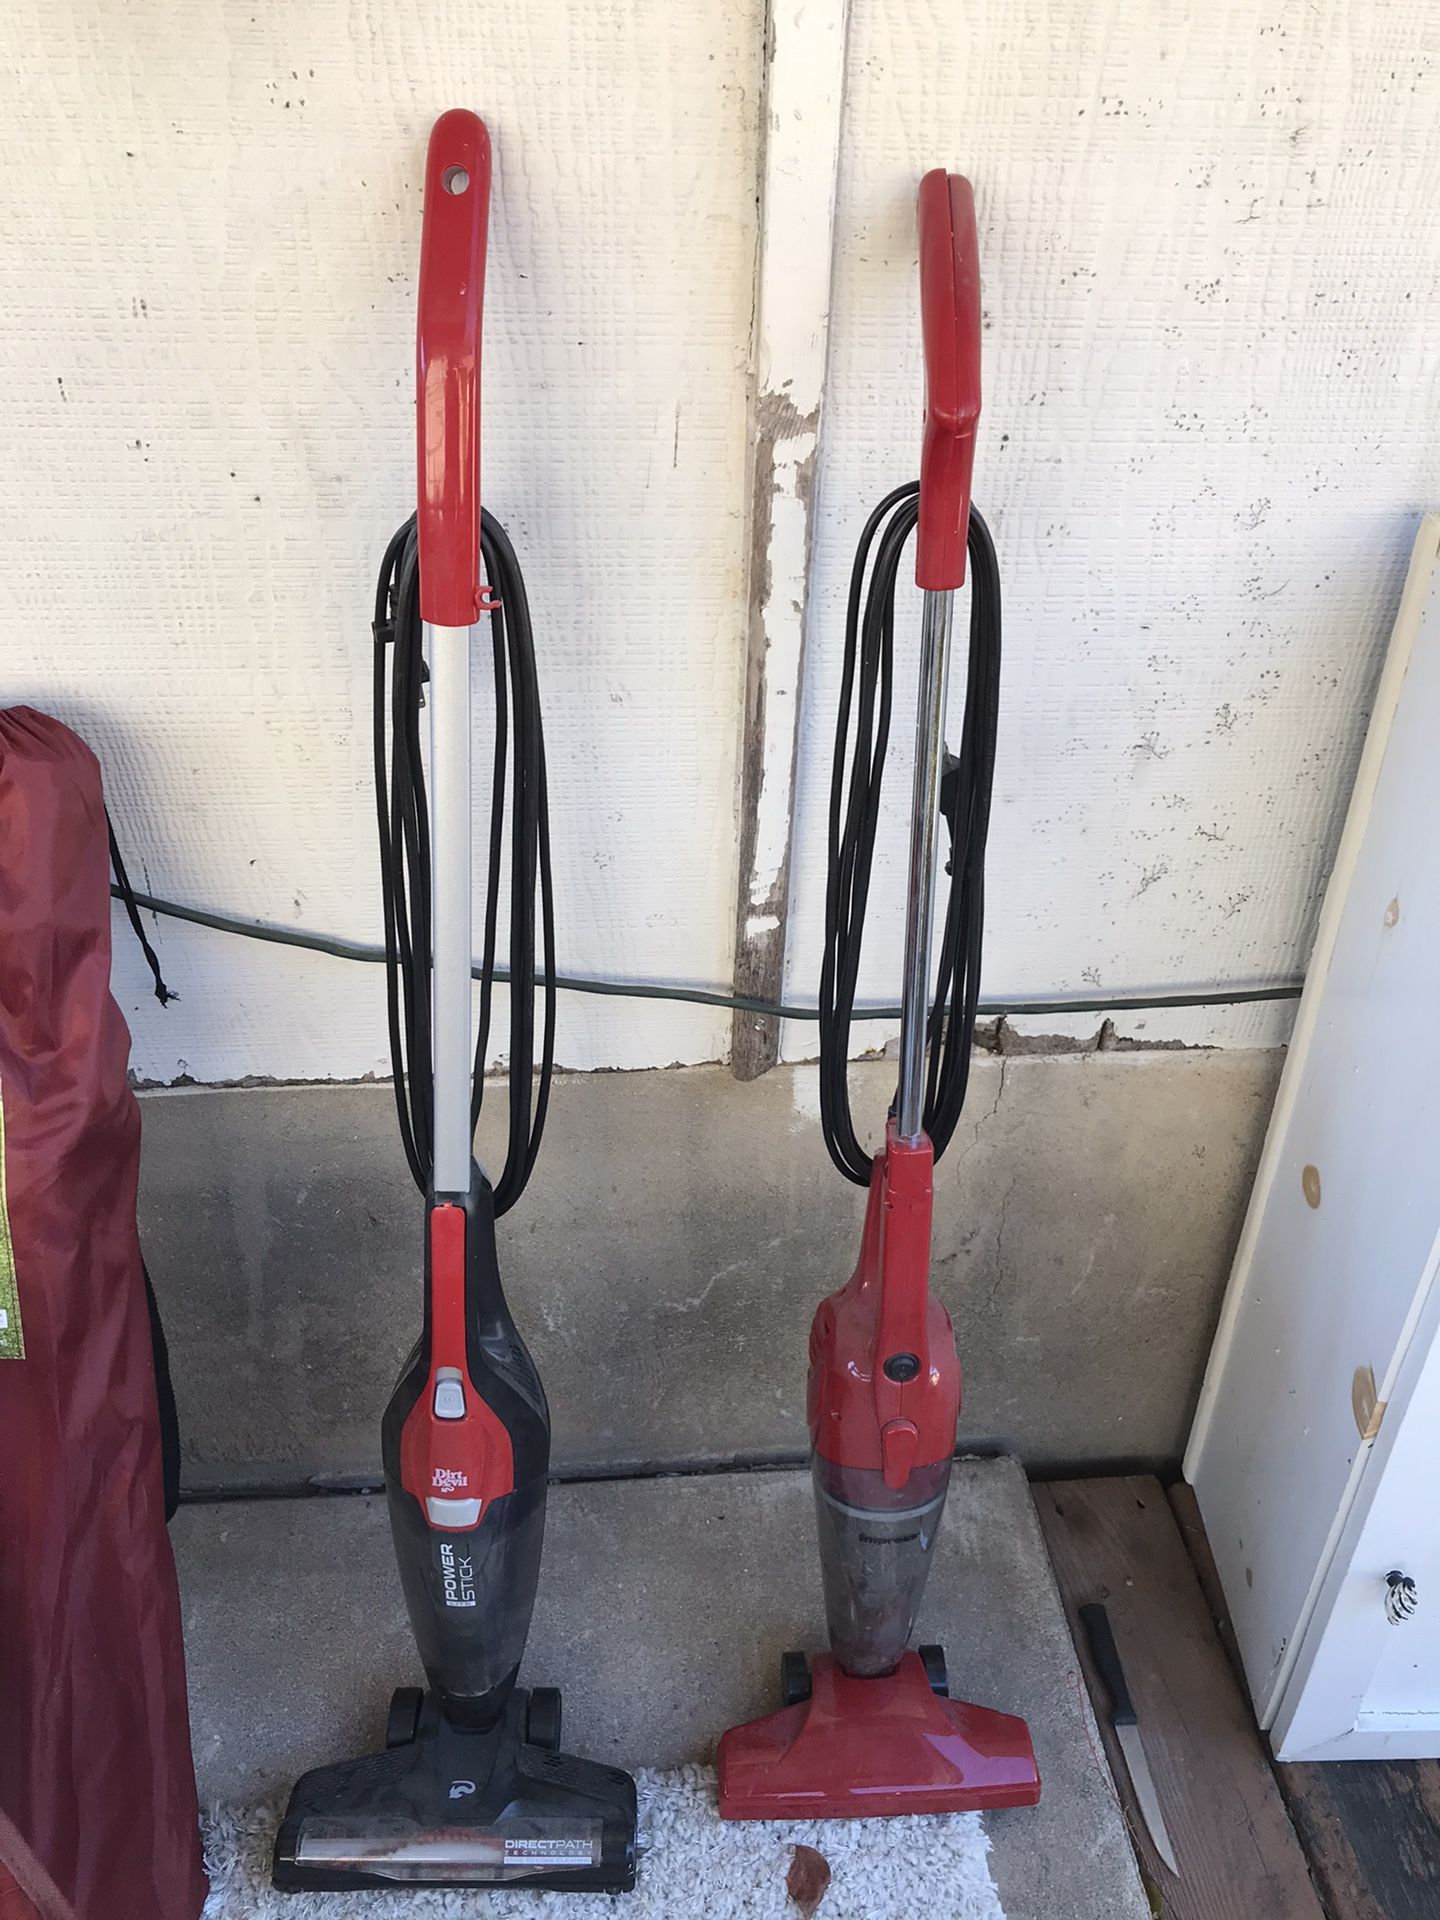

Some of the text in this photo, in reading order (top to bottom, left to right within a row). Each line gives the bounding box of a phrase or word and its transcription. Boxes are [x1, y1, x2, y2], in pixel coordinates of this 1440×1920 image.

[434, 1468, 463, 1480] Dirt
[431, 1476, 469, 1489] Devil
[440, 1543, 459, 1600] POWER
[458, 1556, 476, 1601] STICK
[504, 1839, 593, 1849] DIRECTPATH
